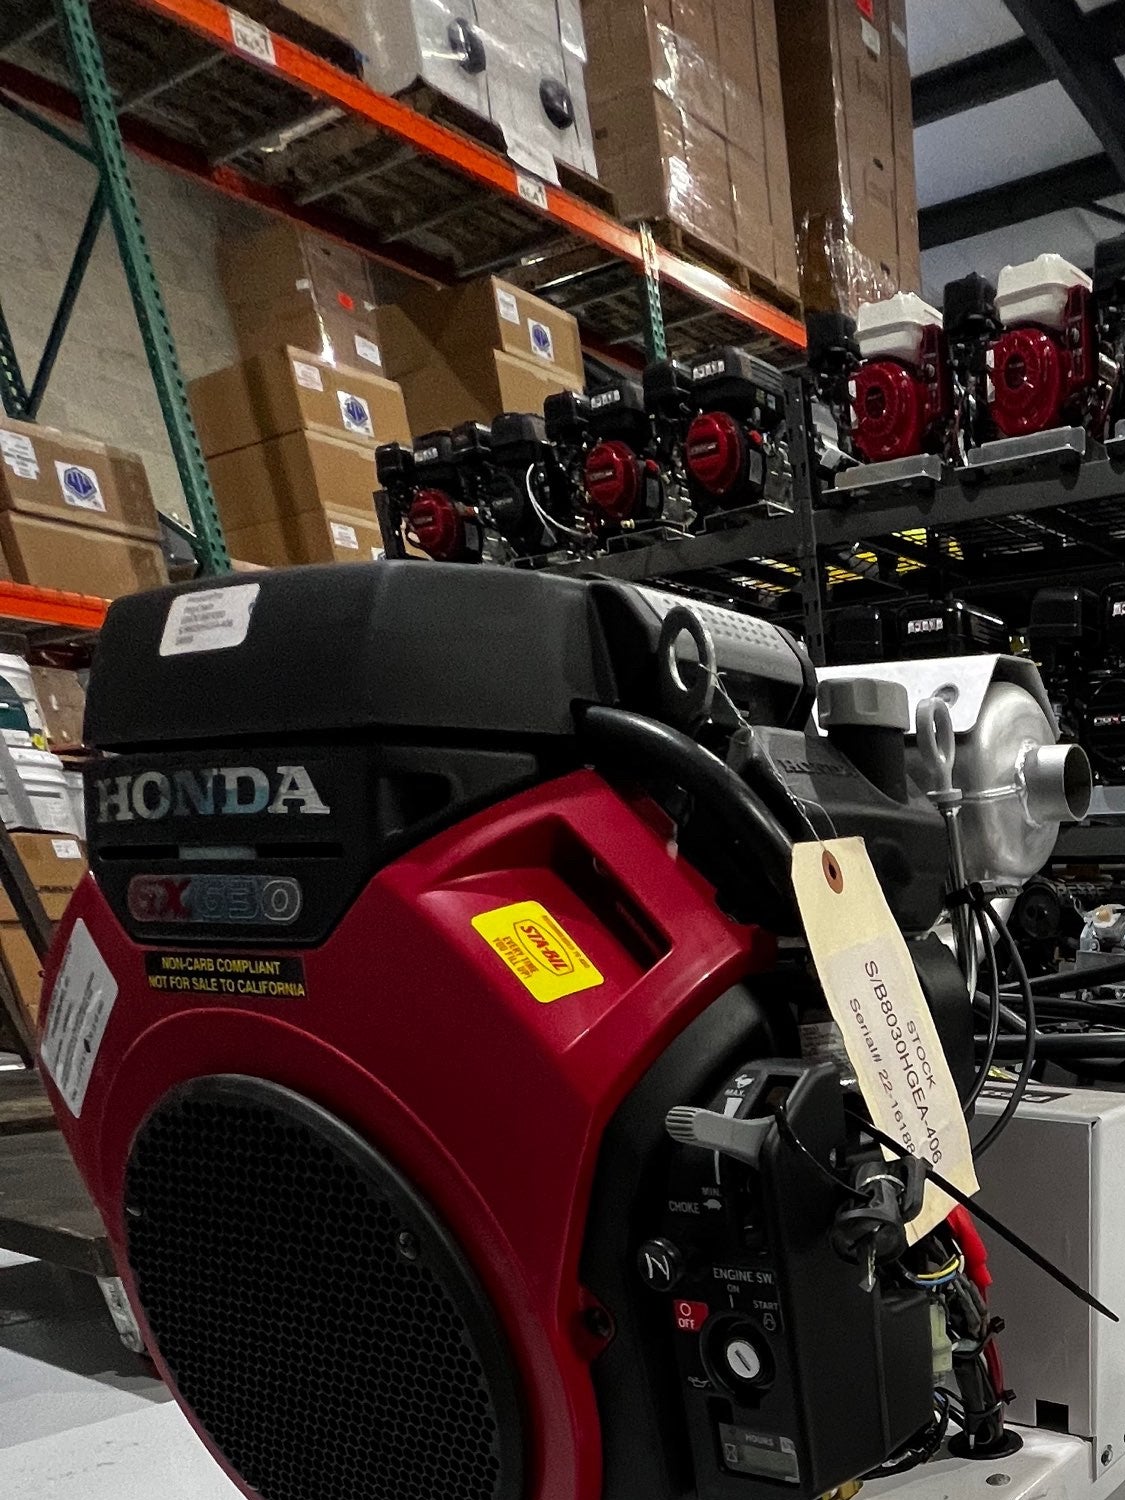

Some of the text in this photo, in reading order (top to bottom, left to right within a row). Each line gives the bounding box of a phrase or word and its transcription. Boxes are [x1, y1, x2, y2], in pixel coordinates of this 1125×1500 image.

[97, 766, 330, 823] HONDA
[493, 937, 508, 951] YOU
[504, 951, 520, 966] FILL
[503, 936, 524, 958] EVERY
[520, 925, 568, 970] STA-BIL
[162, 956, 281, 975] NON-CARB COMPLIANT
[149, 975, 306, 996] NOT FOR SALE TO CALIFORNIA
[849, 998, 883, 1063] Serial#
[864, 960, 943, 1165] S/B8030HGEA-406
[906, 1020, 937, 1090] STOCK
[668, 1200, 700, 1214] CHOKE
[713, 1267, 775, 1285] ENGINE SW.
[727, 1284, 740, 1293] ON
[753, 1300, 779, 1311] START
[678, 1317, 695, 1329] OFF
[745, 1434, 774, 1446] HOURS
